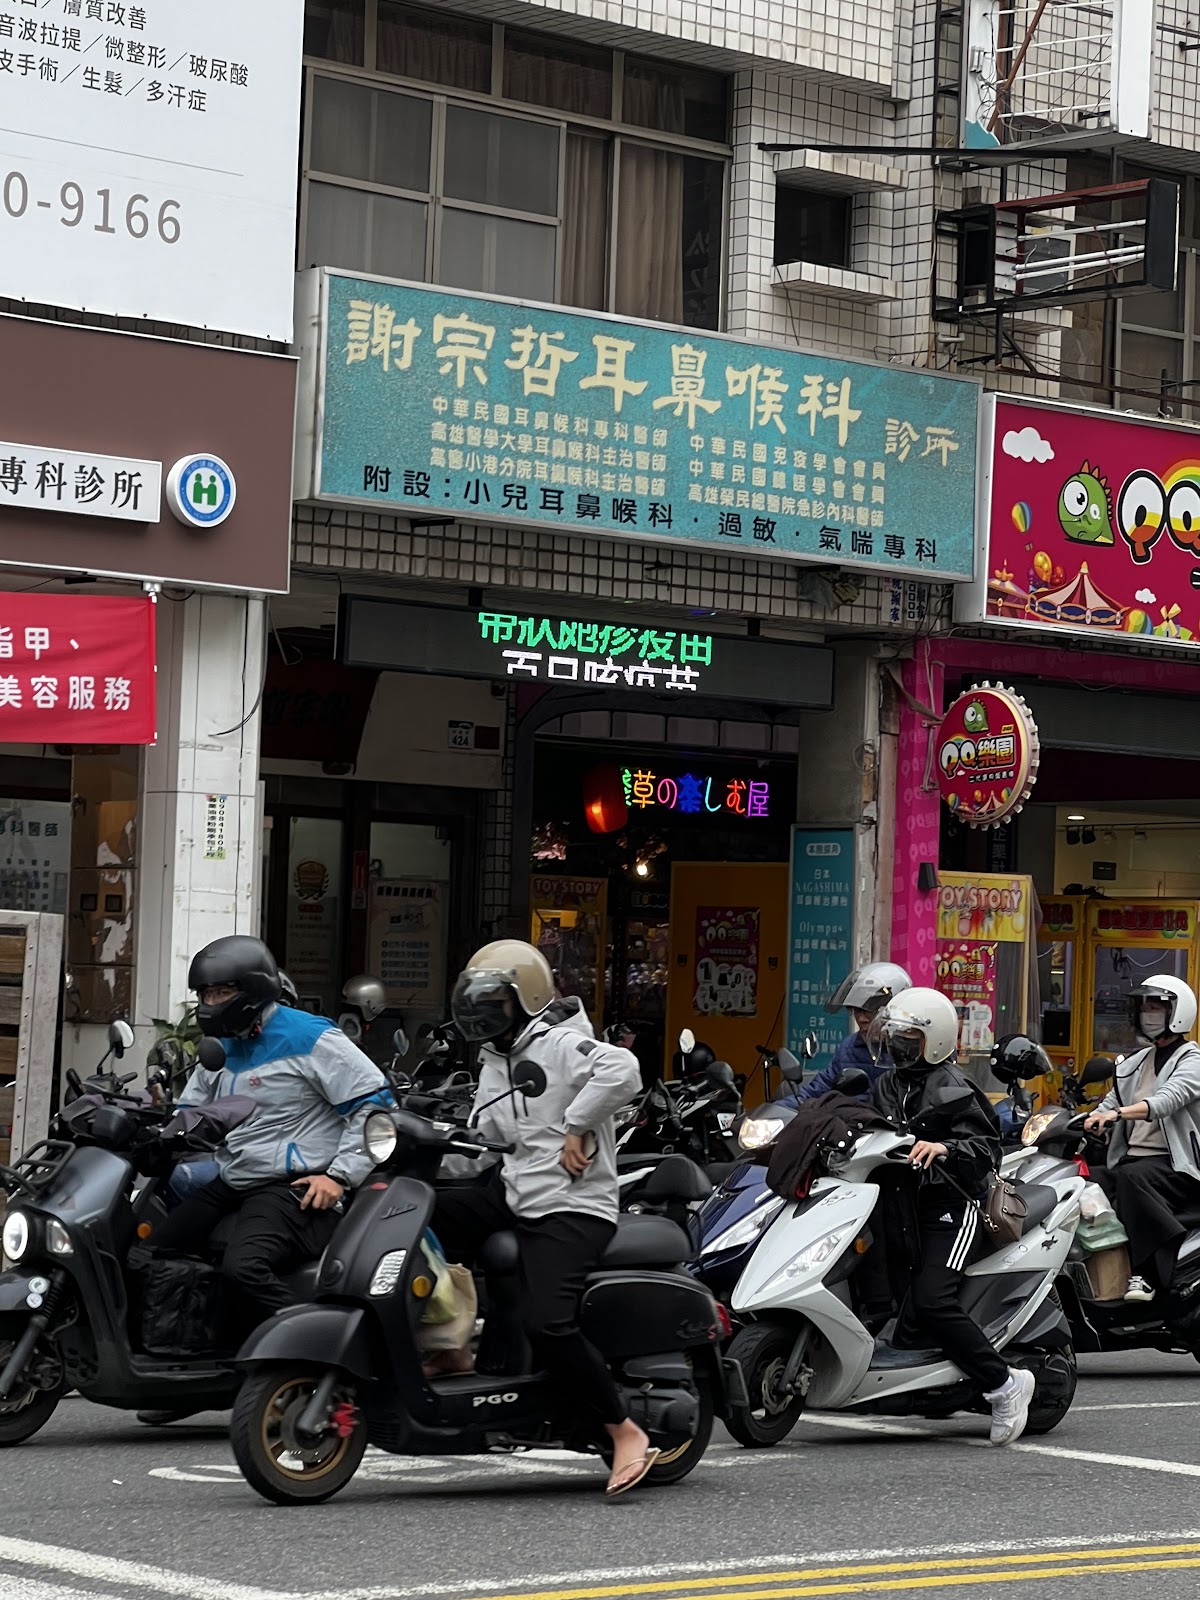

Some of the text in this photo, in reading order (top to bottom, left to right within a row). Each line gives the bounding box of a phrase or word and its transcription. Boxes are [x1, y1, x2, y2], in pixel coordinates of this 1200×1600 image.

[346, 299, 959, 467] 謝宗哲耳鼻喉科 診所
[432, 396, 668, 447] 中華民國耳鼻喉科專科醫師
[431, 421, 667, 472] 高雄醫學大學耳鼻喉科主治醫師
[690, 434, 885, 481] 中華民國免疫學會會員
[0, 456, 143, 511] 專科診所
[0, 674, 132, 711] 美容服務
[794, 881, 849, 894] NAGASHIMA
[968, 887, 1022, 913] STORY
[799, 921, 844, 937] Olympus
[473, 1393, 519, 1407] PGO
